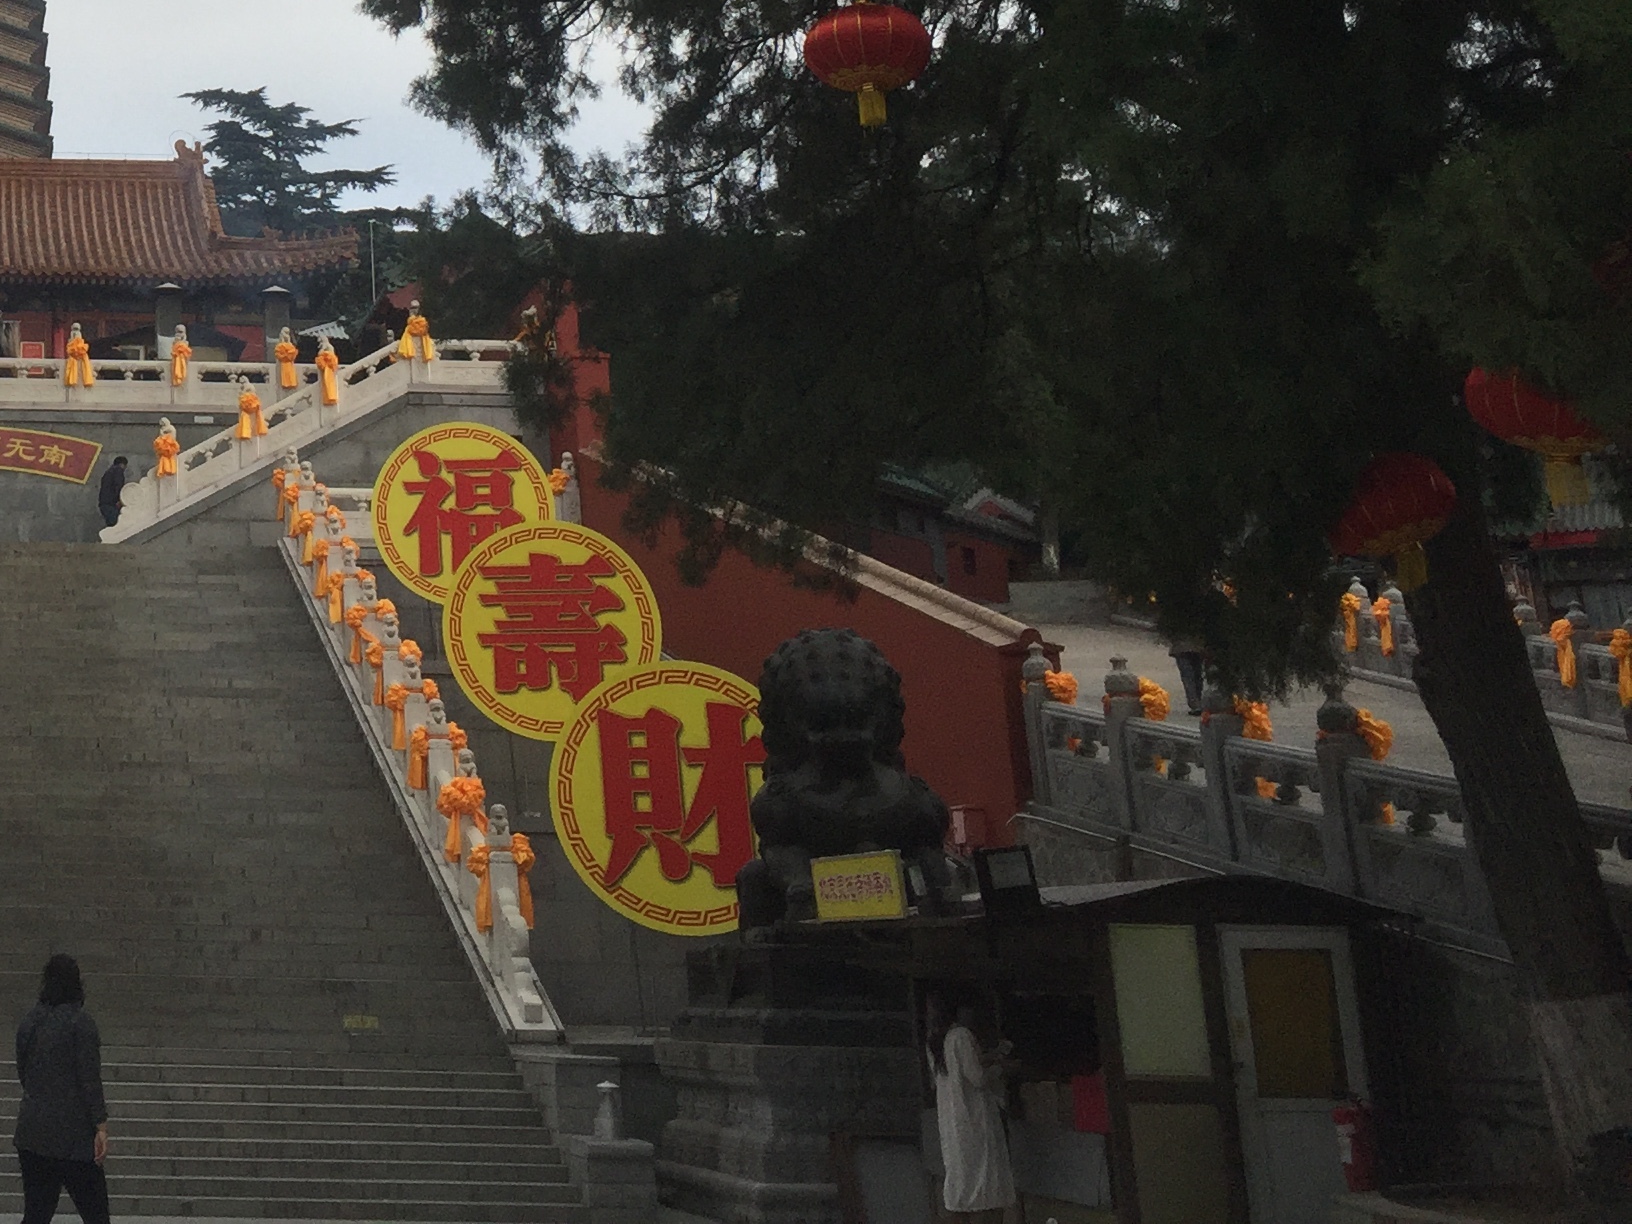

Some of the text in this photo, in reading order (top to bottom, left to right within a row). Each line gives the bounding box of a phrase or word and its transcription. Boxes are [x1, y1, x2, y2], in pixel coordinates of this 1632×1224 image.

[403, 449, 525, 576] 福
[477, 553, 627, 701] 壽
[596, 701, 767, 888] 財
